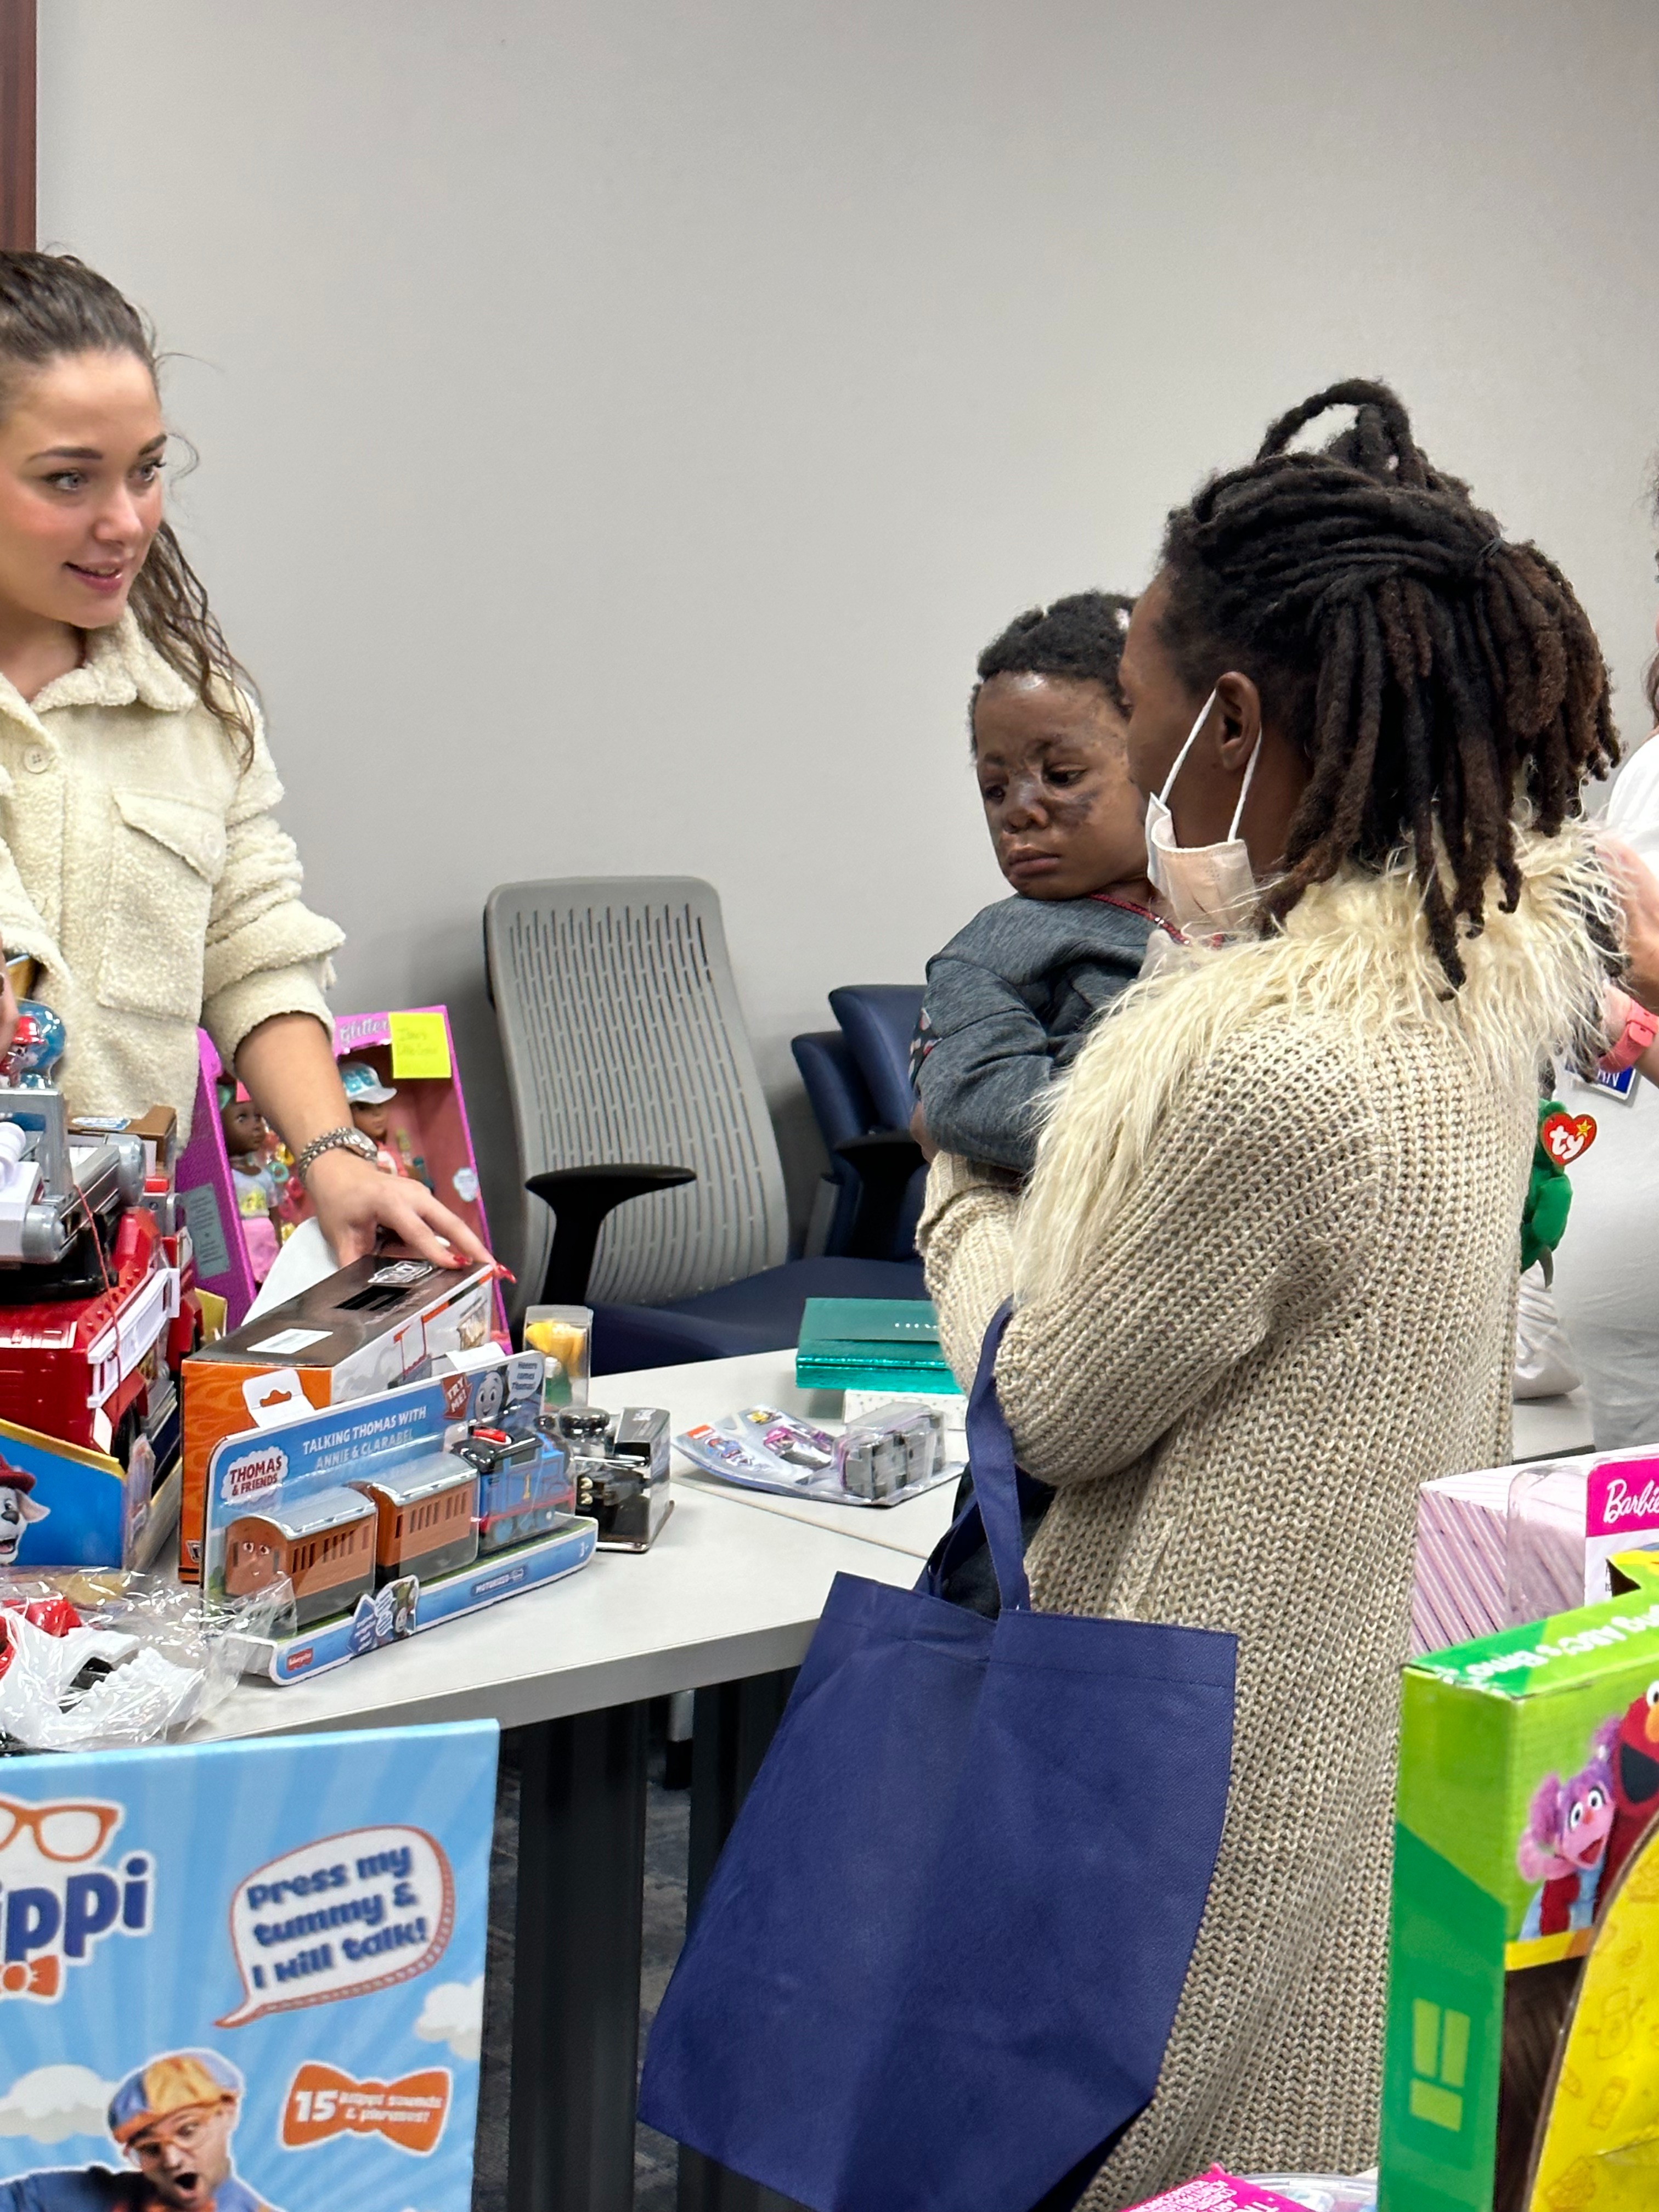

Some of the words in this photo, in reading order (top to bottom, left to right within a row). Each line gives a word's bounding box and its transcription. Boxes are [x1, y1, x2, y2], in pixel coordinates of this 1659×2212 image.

[1549, 1125, 1585, 1160] ty
[447, 1376, 464, 1400] TRY
[451, 1389, 467, 1413] ME!
[302, 1428, 351, 1455] TALKING
[352, 1414, 397, 1440] THOMAS
[398, 1405, 427, 1426] WITH
[229, 1455, 283, 1485] THOMAS
[314, 1448, 350, 1471] ANNIE
[351, 1444, 359, 1459] &
[232, 1486, 239, 1497] &
[240, 1472, 279, 1494] FRIENDS
[356, 1846, 411, 1879] my
[0, 1857, 149, 1964] ppi
[253, 1894, 385, 1947] tummy
[393, 1881, 419, 1907] &
[274, 1943, 334, 1982] will
[341, 1916, 428, 1961] talk!
[295, 2090, 338, 2122] 15
